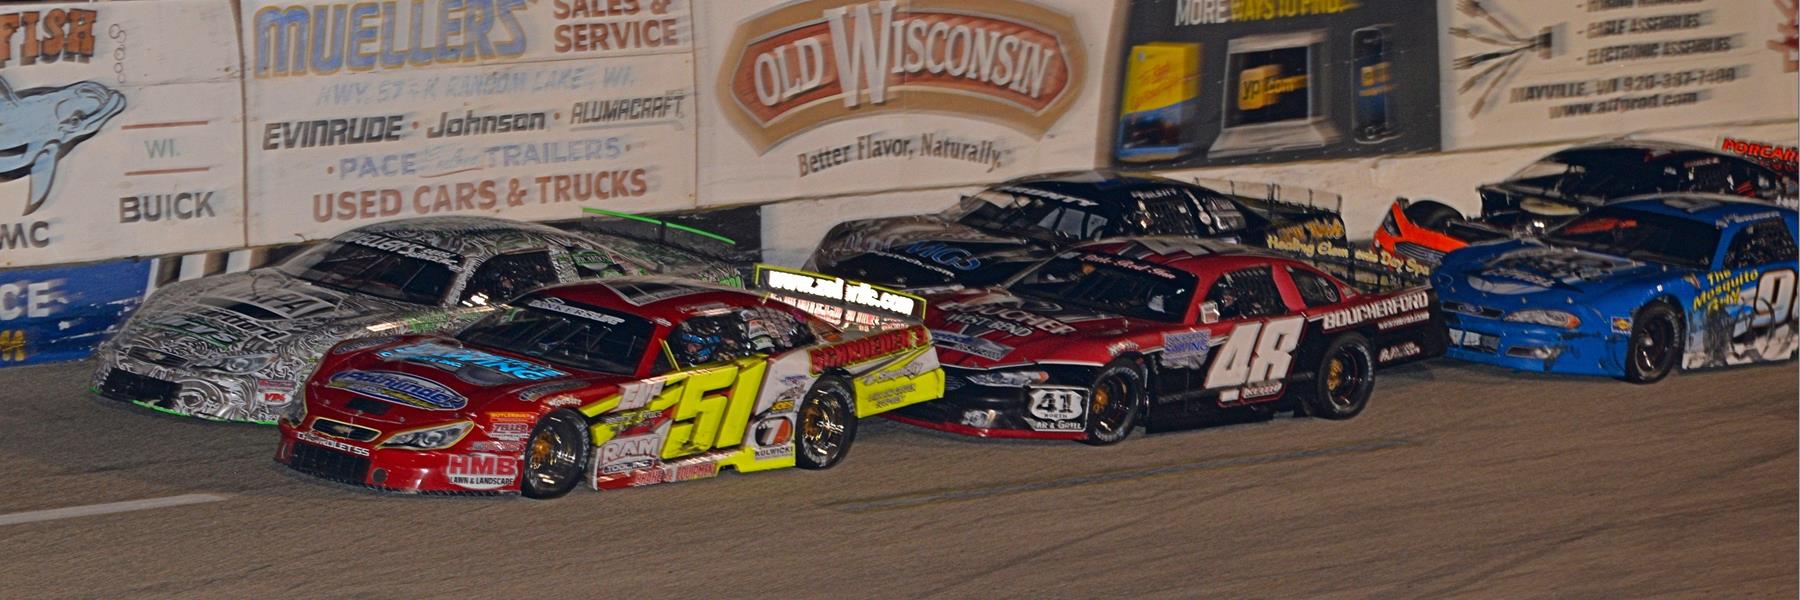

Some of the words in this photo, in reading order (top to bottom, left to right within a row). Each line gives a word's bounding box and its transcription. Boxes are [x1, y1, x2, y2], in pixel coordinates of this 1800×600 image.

[553, 0, 641, 20] SALES
[1175, 0, 1228, 26] MORE
[0, 9, 96, 62] FISH
[554, 19, 679, 53] SERVICE
[754, 36, 825, 107] OLD
[823, 0, 1054, 108] WISCONSIN
[262, 114, 404, 150] EVINRUDE
[427, 110, 544, 139] Johnson
[570, 95, 684, 124] ALUMACRAFT
[339, 153, 416, 179] PACE
[482, 137, 622, 168] TRAILERS
[797, 144, 850, 178] Better
[856, 134, 914, 161] Flavor,
[920, 133, 1001, 174] Naturally.
[119, 192, 215, 224] BUICK
[312, 188, 402, 222] USED
[412, 179, 497, 214] CARS
[506, 178, 528, 207] &
[535, 168, 647, 204] TRUCKS
[0, 221, 50, 249] MC
[1381, 251, 1404, 273] Day
[1406, 258, 1430, 278] Spa
[1707, 269, 1731, 287] The
[0, 282, 50, 320] CE
[1693, 269, 1759, 312] Mosquito
[1204, 315, 1305, 389] 48
[661, 352, 769, 459] 51
[1036, 392, 1073, 413] 41
[494, 424, 528, 433] ZELLER
[450, 456, 516, 475] HMB
[601, 440, 657, 463] RAM
[755, 447, 793, 457] KULWICKI
[451, 476, 469, 485] LAWN
[469, 477, 476, 485] &
[476, 476, 514, 485] LANDSCAPE
